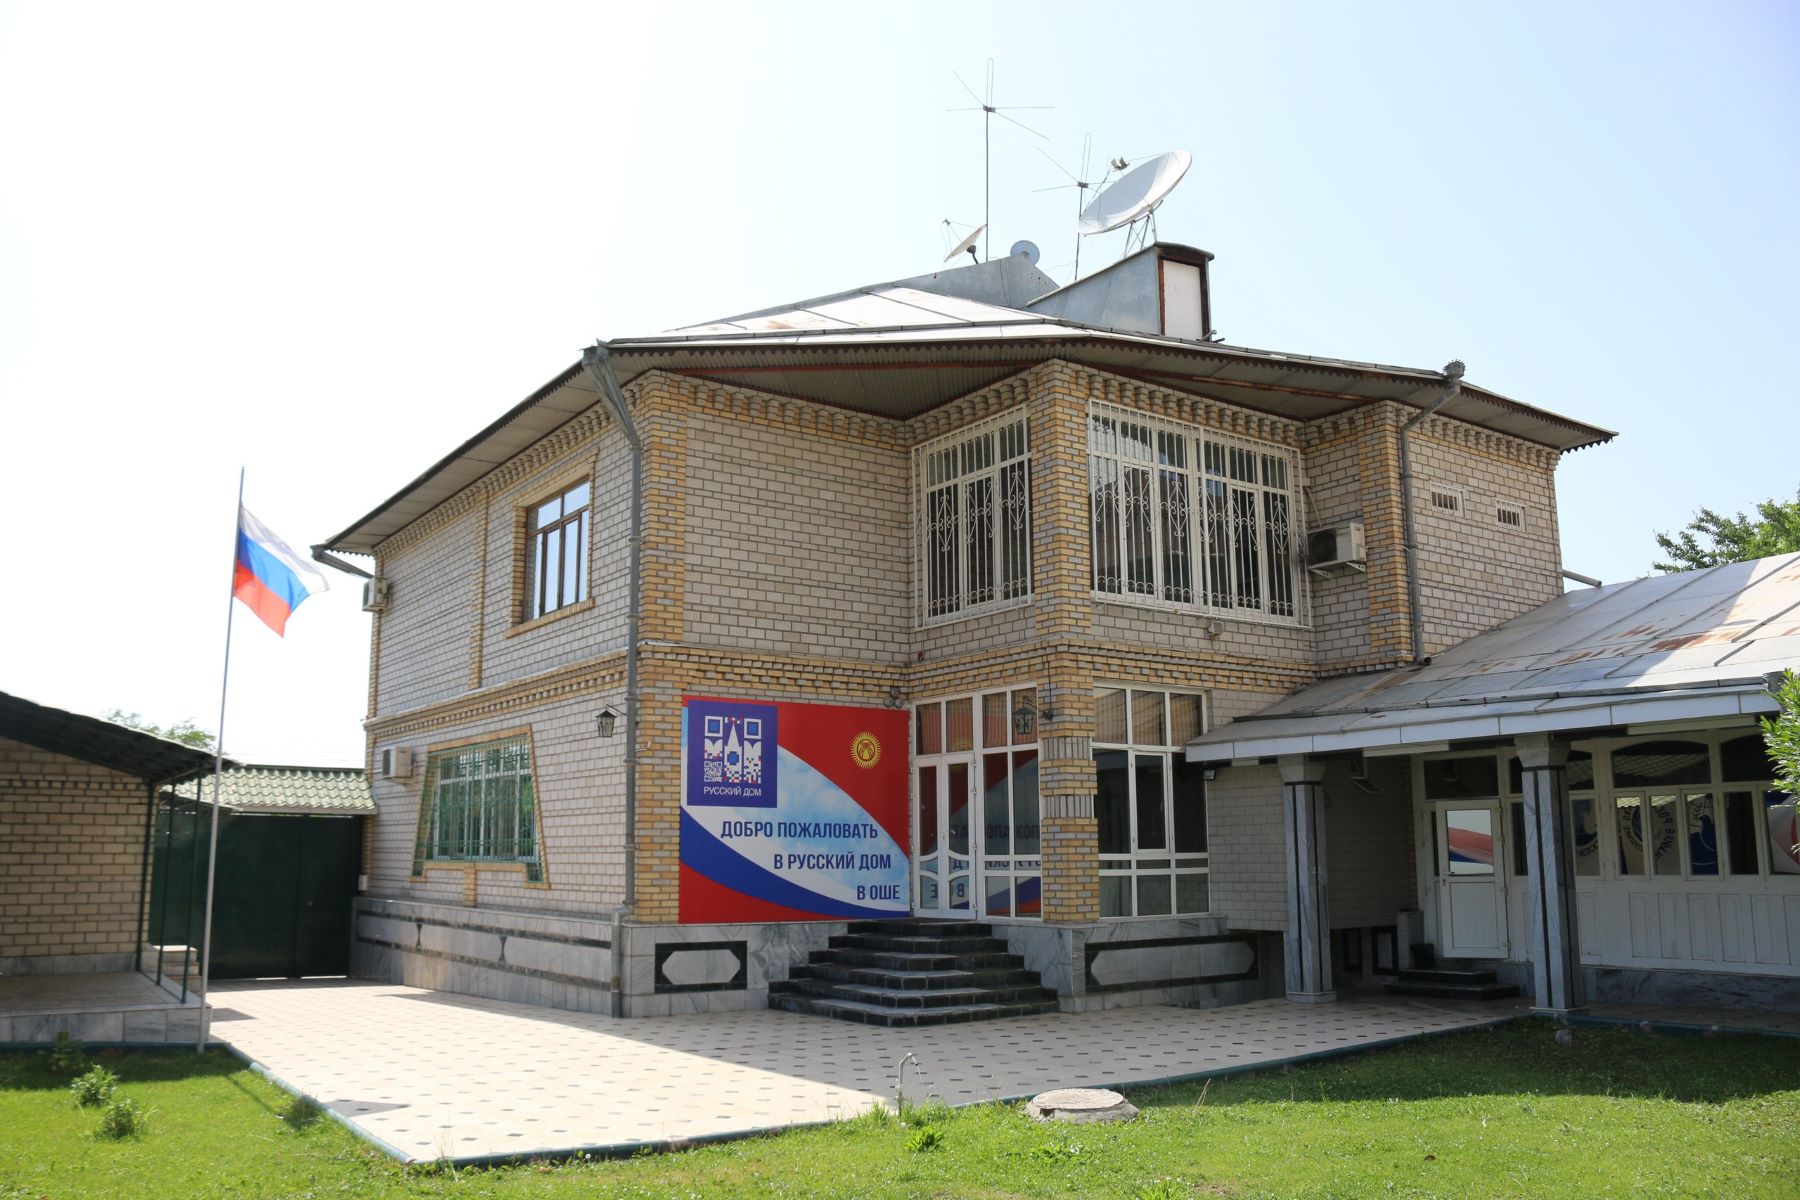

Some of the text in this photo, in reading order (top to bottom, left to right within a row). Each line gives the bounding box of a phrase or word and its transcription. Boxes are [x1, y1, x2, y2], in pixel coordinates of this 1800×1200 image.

[703, 786, 761, 797] РУССКИЙ ДОМ
[720, 821, 877, 838] ДОБРО ПОЖАЛОВАТЬ
[774, 851, 890, 871] В РУССКИЙ ДОМ
[857, 885, 900, 900] В ОШЕ
